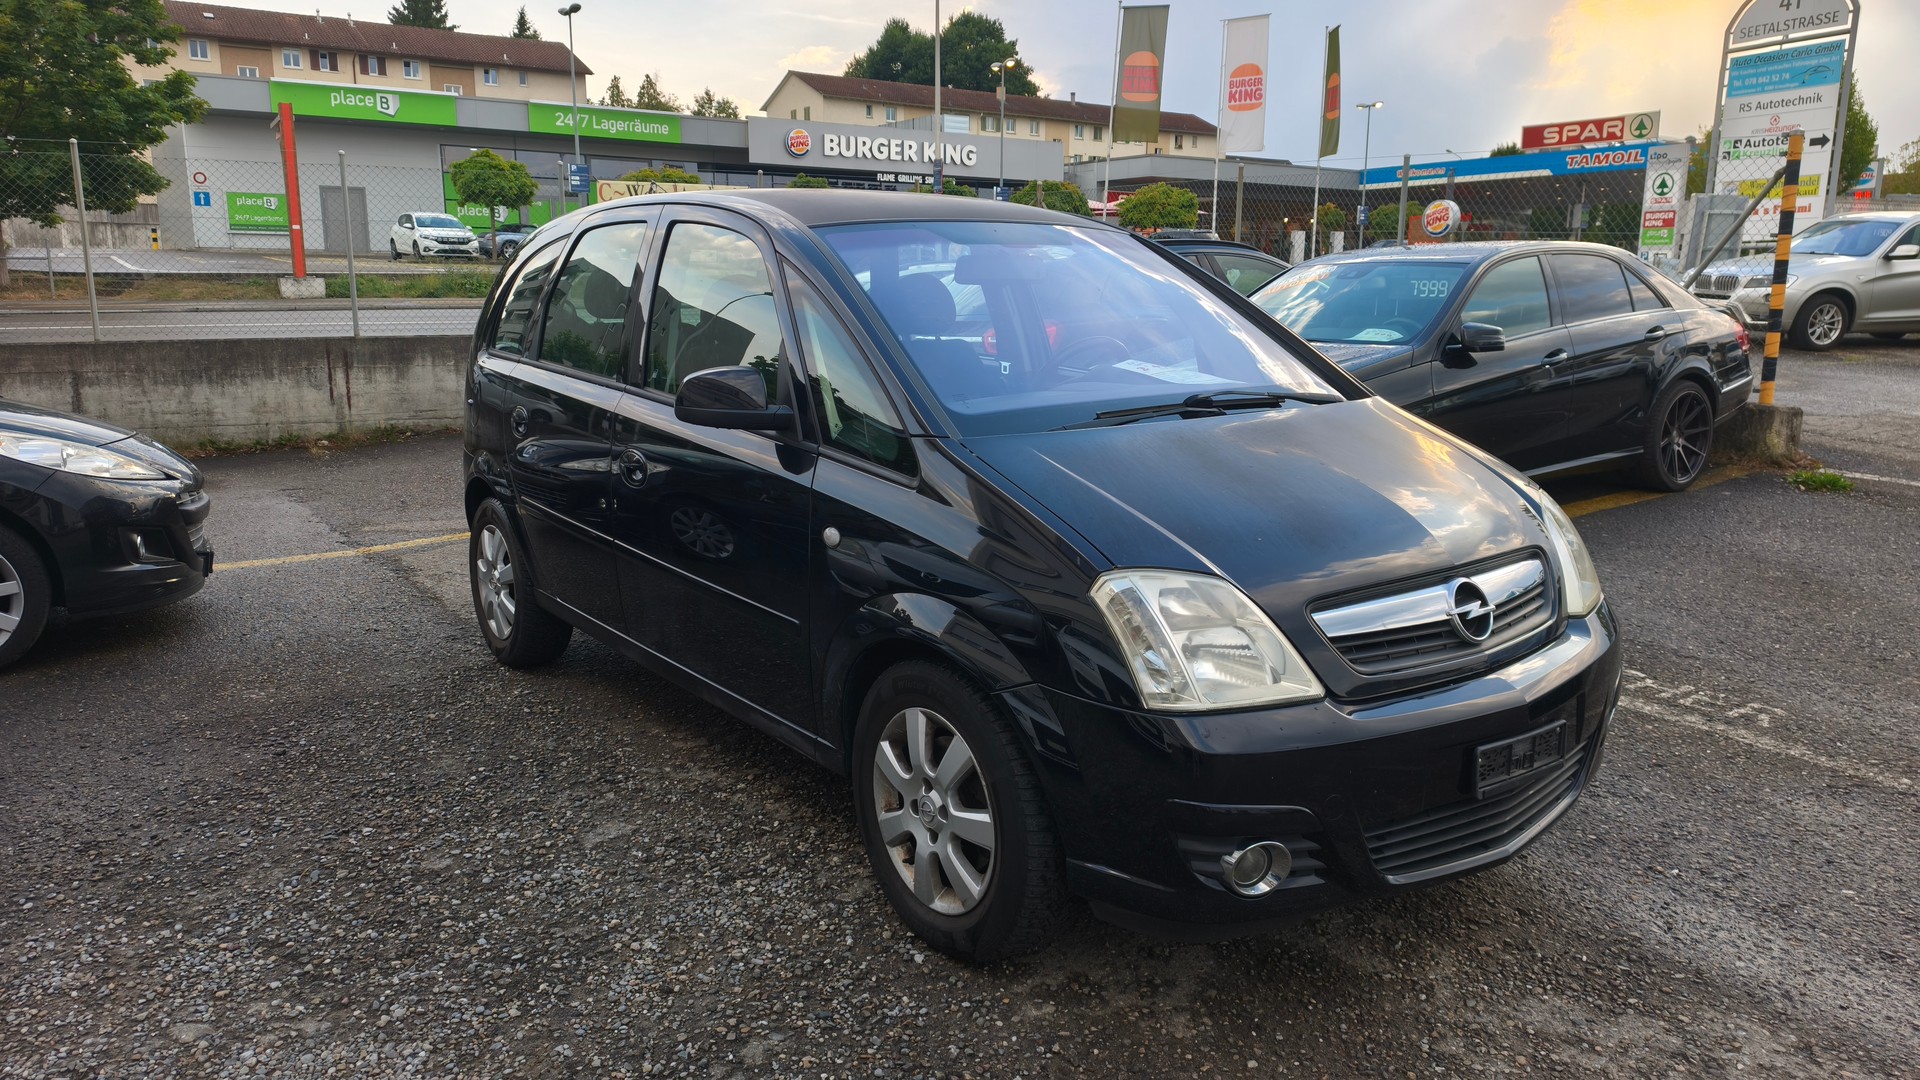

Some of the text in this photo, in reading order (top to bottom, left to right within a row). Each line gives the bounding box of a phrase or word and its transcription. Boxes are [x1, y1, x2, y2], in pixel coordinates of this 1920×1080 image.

[1739, 10, 1840, 39] SEETALSTRASSE
[1732, 42, 1842, 68] Auto Occasion Carlo GmbH
[1229, 77, 1264, 89] BURGER
[331, 90, 390, 110] place B
[1228, 88, 1264, 103] KING
[1739, 92, 1823, 113] RS Autotechnik
[593, 115, 669, 135] Lagerräume
[1543, 120, 1623, 144] SPAR
[790, 134, 809, 142] BURGER
[790, 140, 809, 149] KING
[823, 133, 978, 167] BURGER KING
[1567, 149, 1645, 169] TAMOIL
[877, 173, 896, 182] FLAME
[898, 174, 923, 183] GRILLING
[236, 196, 273, 207] place B
[457, 205, 490, 217] place
[1645, 211, 1675, 220] BURGER
[1426, 213, 1450, 228] KING
[1644, 219, 1663, 227] KING
